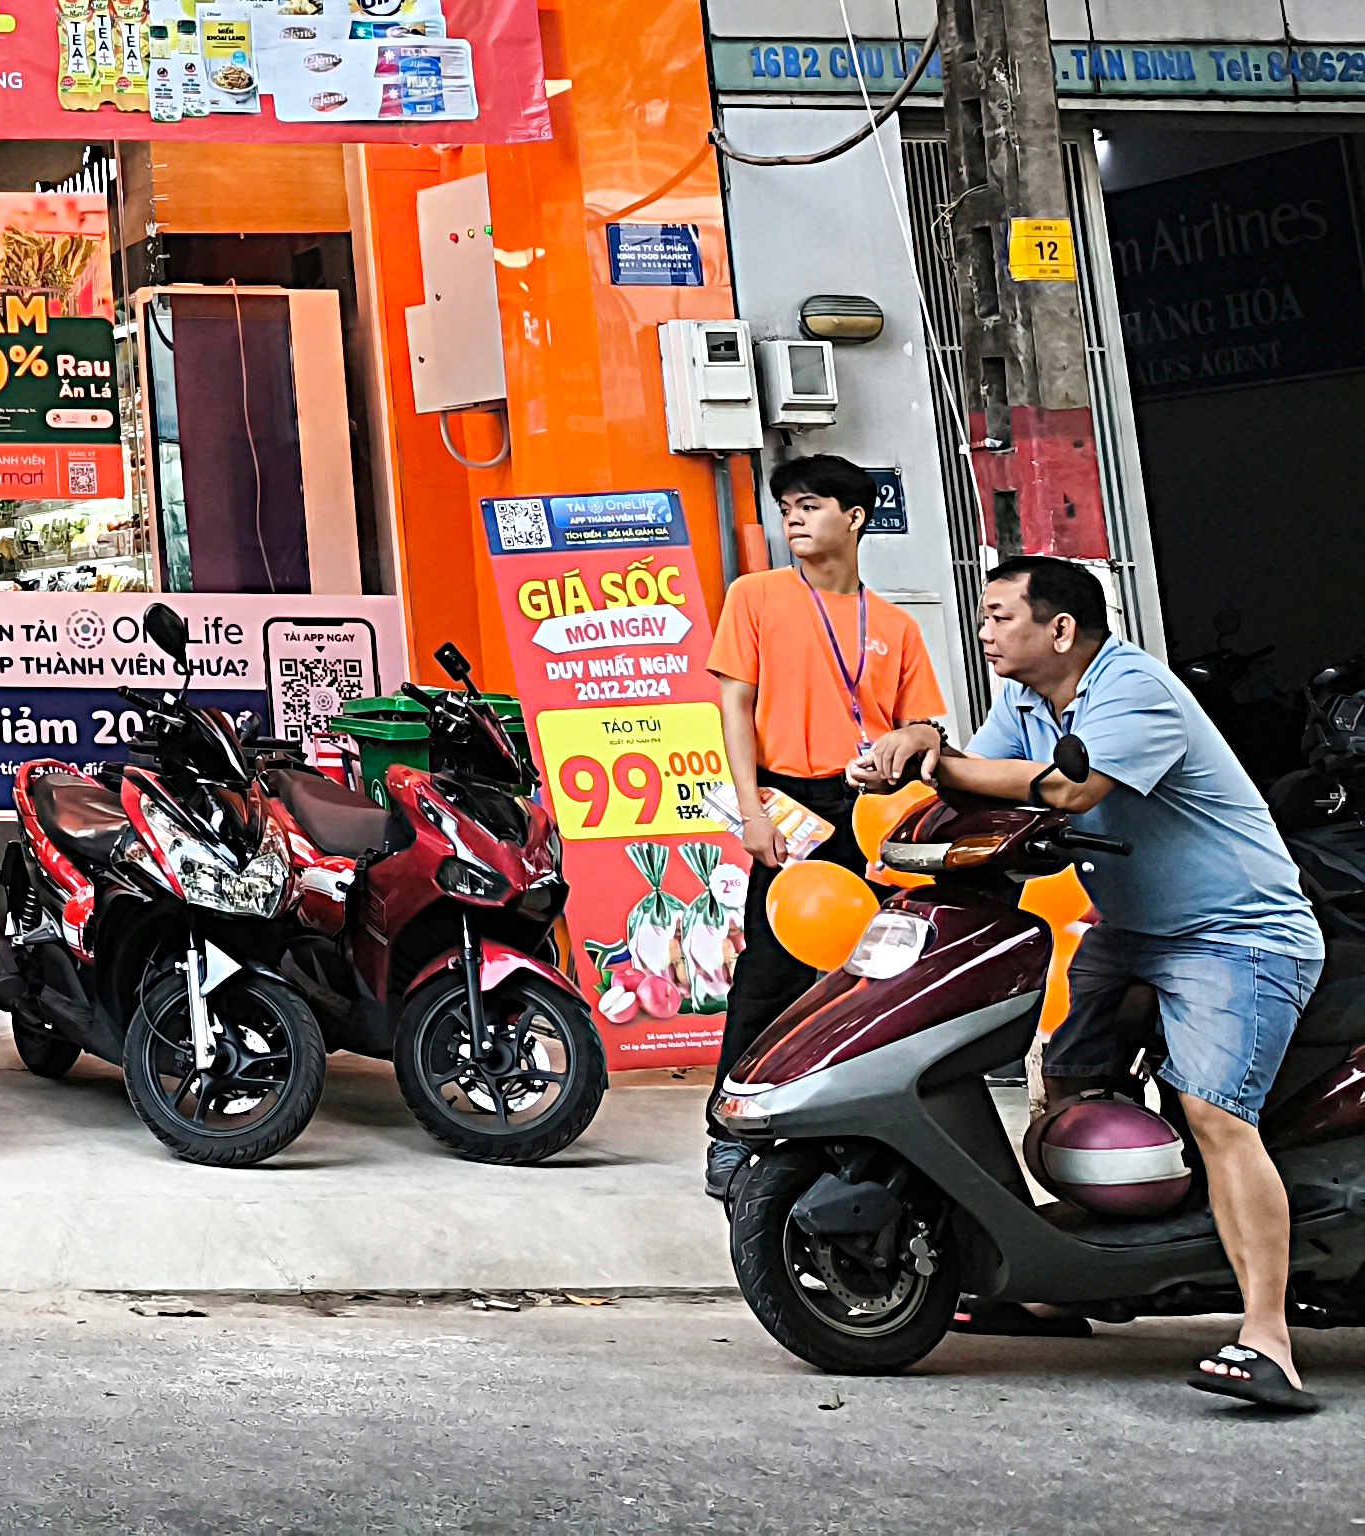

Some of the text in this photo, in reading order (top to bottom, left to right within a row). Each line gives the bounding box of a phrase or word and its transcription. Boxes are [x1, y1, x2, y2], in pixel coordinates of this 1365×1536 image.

[749, 46, 821, 80] 16B2
[1209, 49, 1259, 83] Tel:
[1150, 198, 1329, 272] Airlines
[1035, 240, 1059, 261] 12
[1224, 277, 1305, 330] HÓA
[56, 354, 110, 377] Rau
[1198, 340, 1286, 381] AGENT
[59, 379, 112, 398] Ăn Lá
[20, 452, 46, 465] VIÊN
[566, 497, 654, 513] TẢI OneLife
[570, 516, 586, 524] APP
[587, 514, 615, 524] THÀNH
[518, 554, 686, 620] GIÁ SỐC
[21, 619, 58, 643] TẢI
[284, 630, 355, 642] TẢI APP NGAY
[610, 613, 667, 638] NGÀY
[23, 650, 104, 676] THÀNH
[112, 650, 165, 677] VIÊN
[172, 653, 248, 677] CHƯA?
[545, 652, 689, 681] DUY NHẤT NGÀY
[574, 678, 671, 701] 20.12.2024
[601, 716, 662, 734] TÁO TÚI
